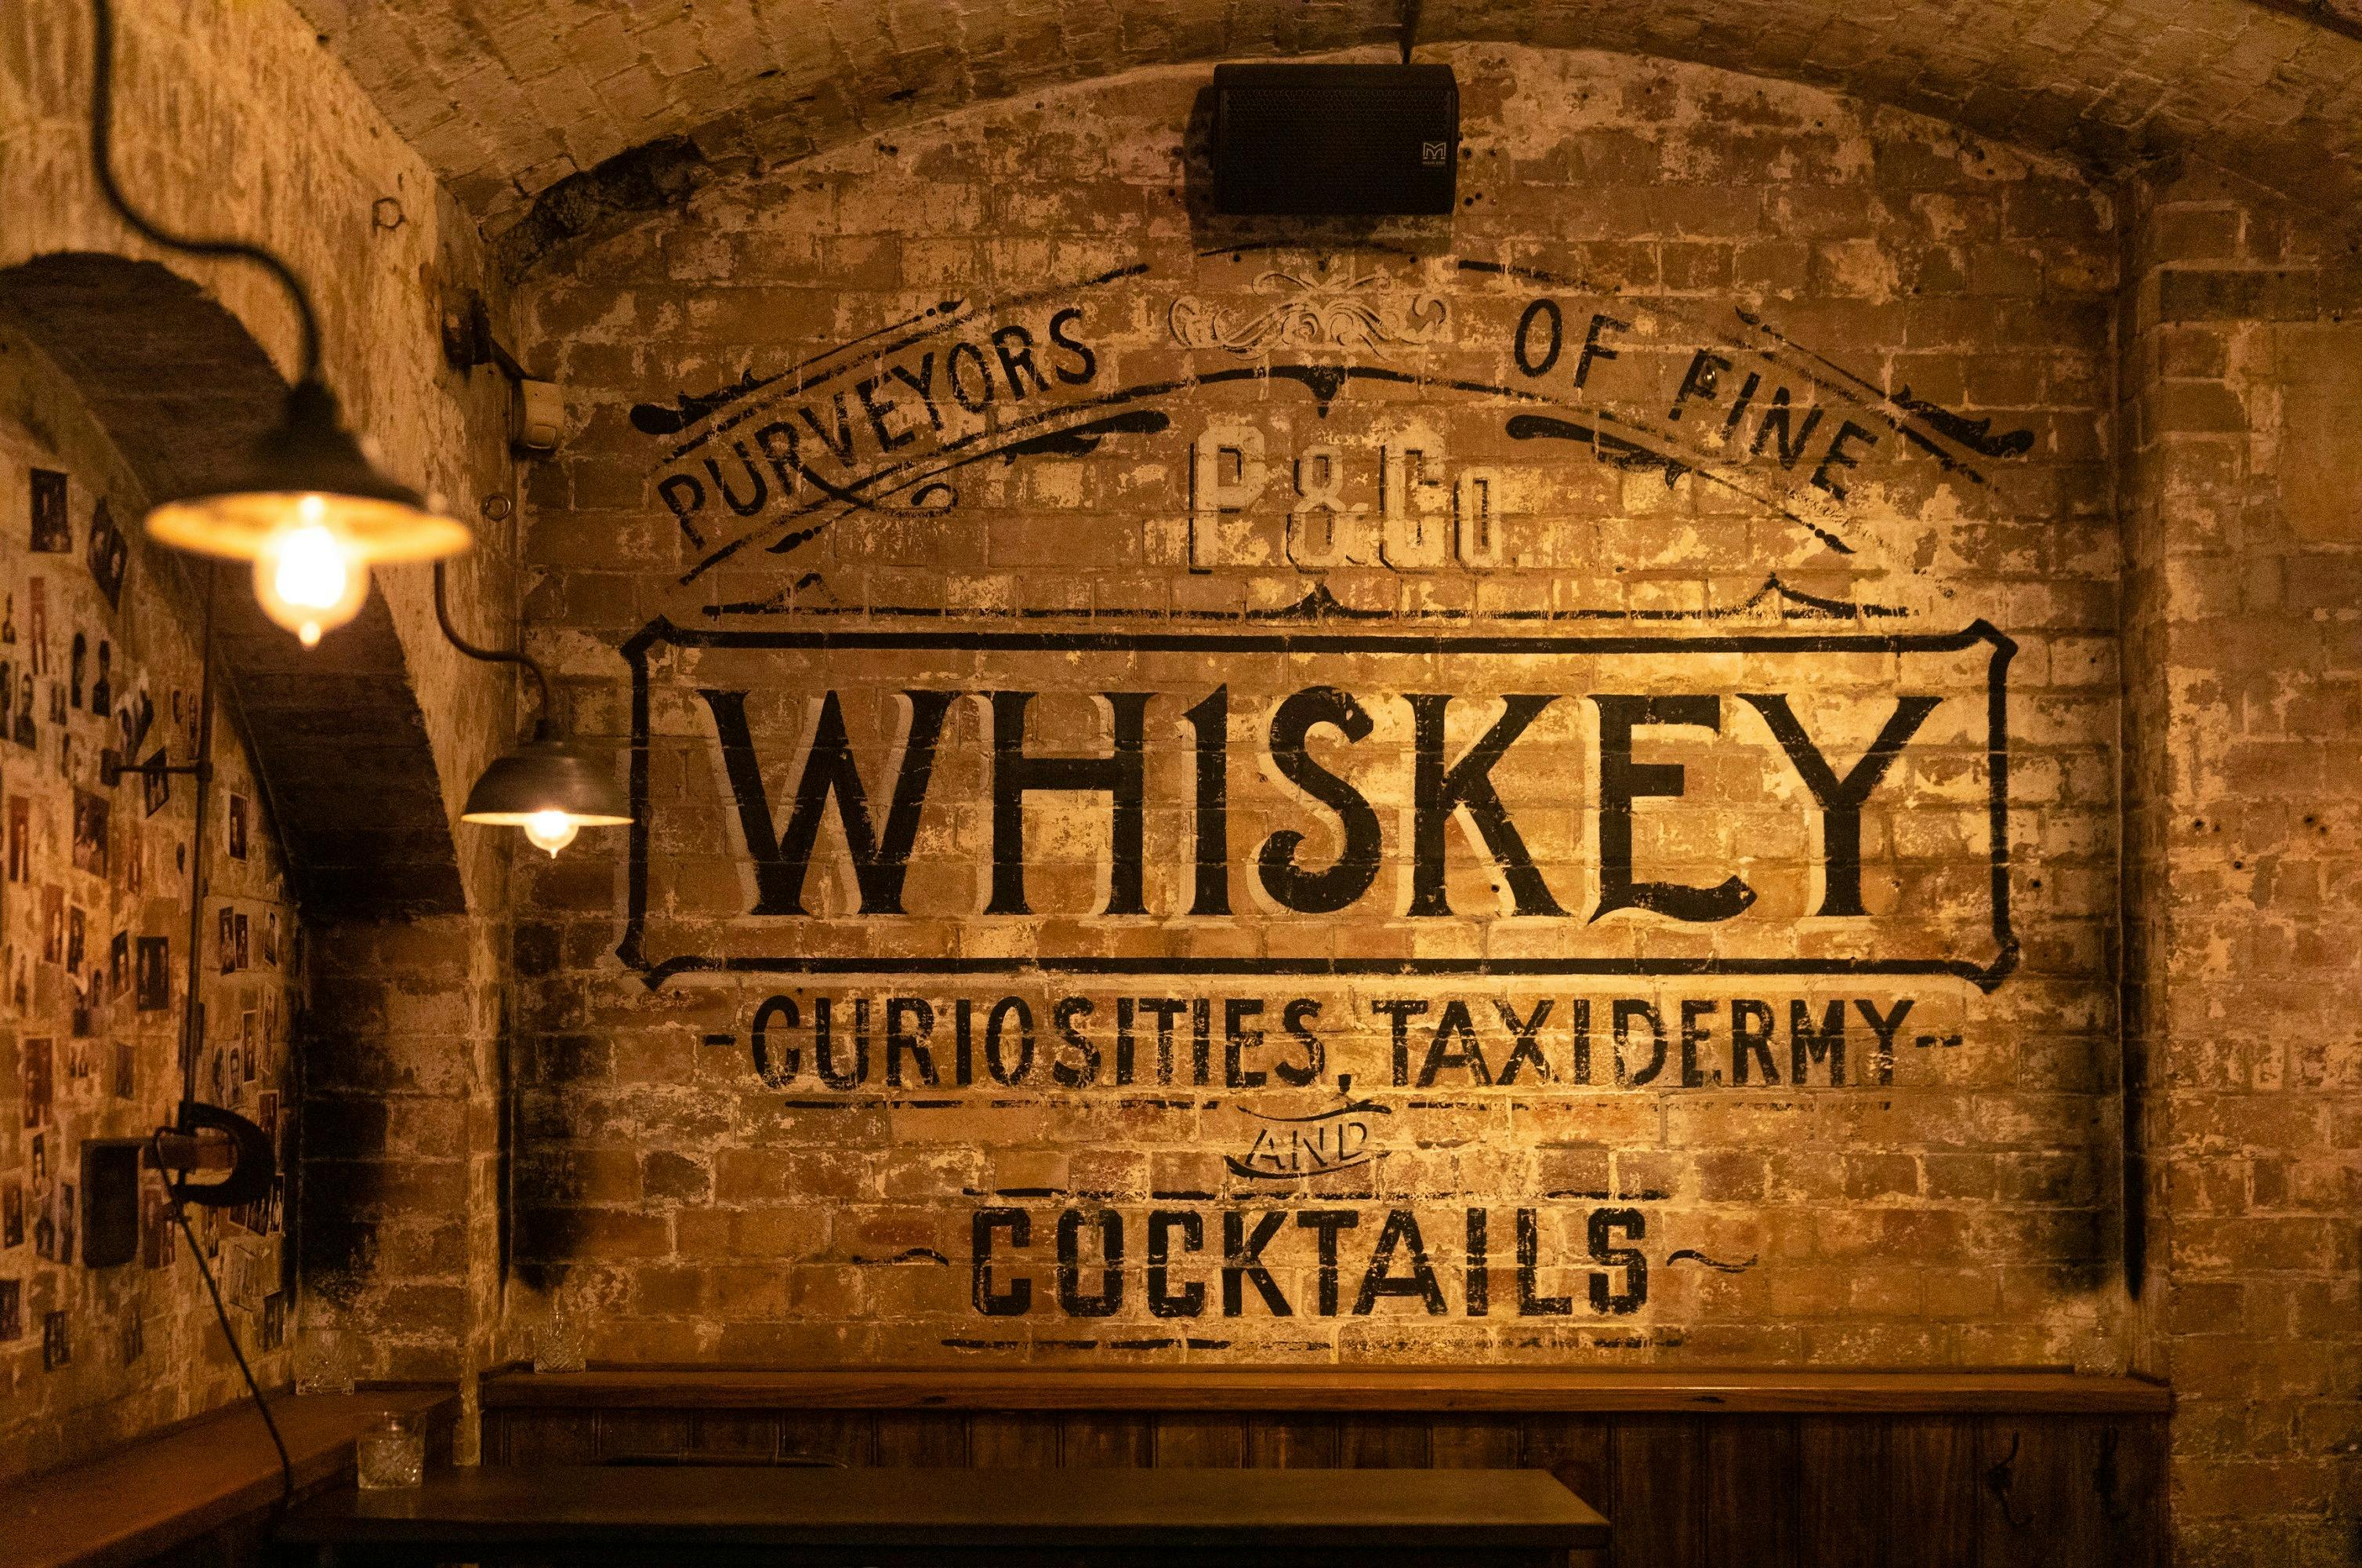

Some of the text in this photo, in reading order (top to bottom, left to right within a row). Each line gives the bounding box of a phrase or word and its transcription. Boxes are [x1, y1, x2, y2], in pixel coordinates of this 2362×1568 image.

[657, 298, 1879, 550] PURVEYORS OF FINE
[698, 684, 1943, 923] WHISKEY
[1371, 998, 1916, 1089] TAXIDERMY
[1244, 1121, 1370, 1171] AND
[971, 1207, 1649, 1318] COCKTAILS
